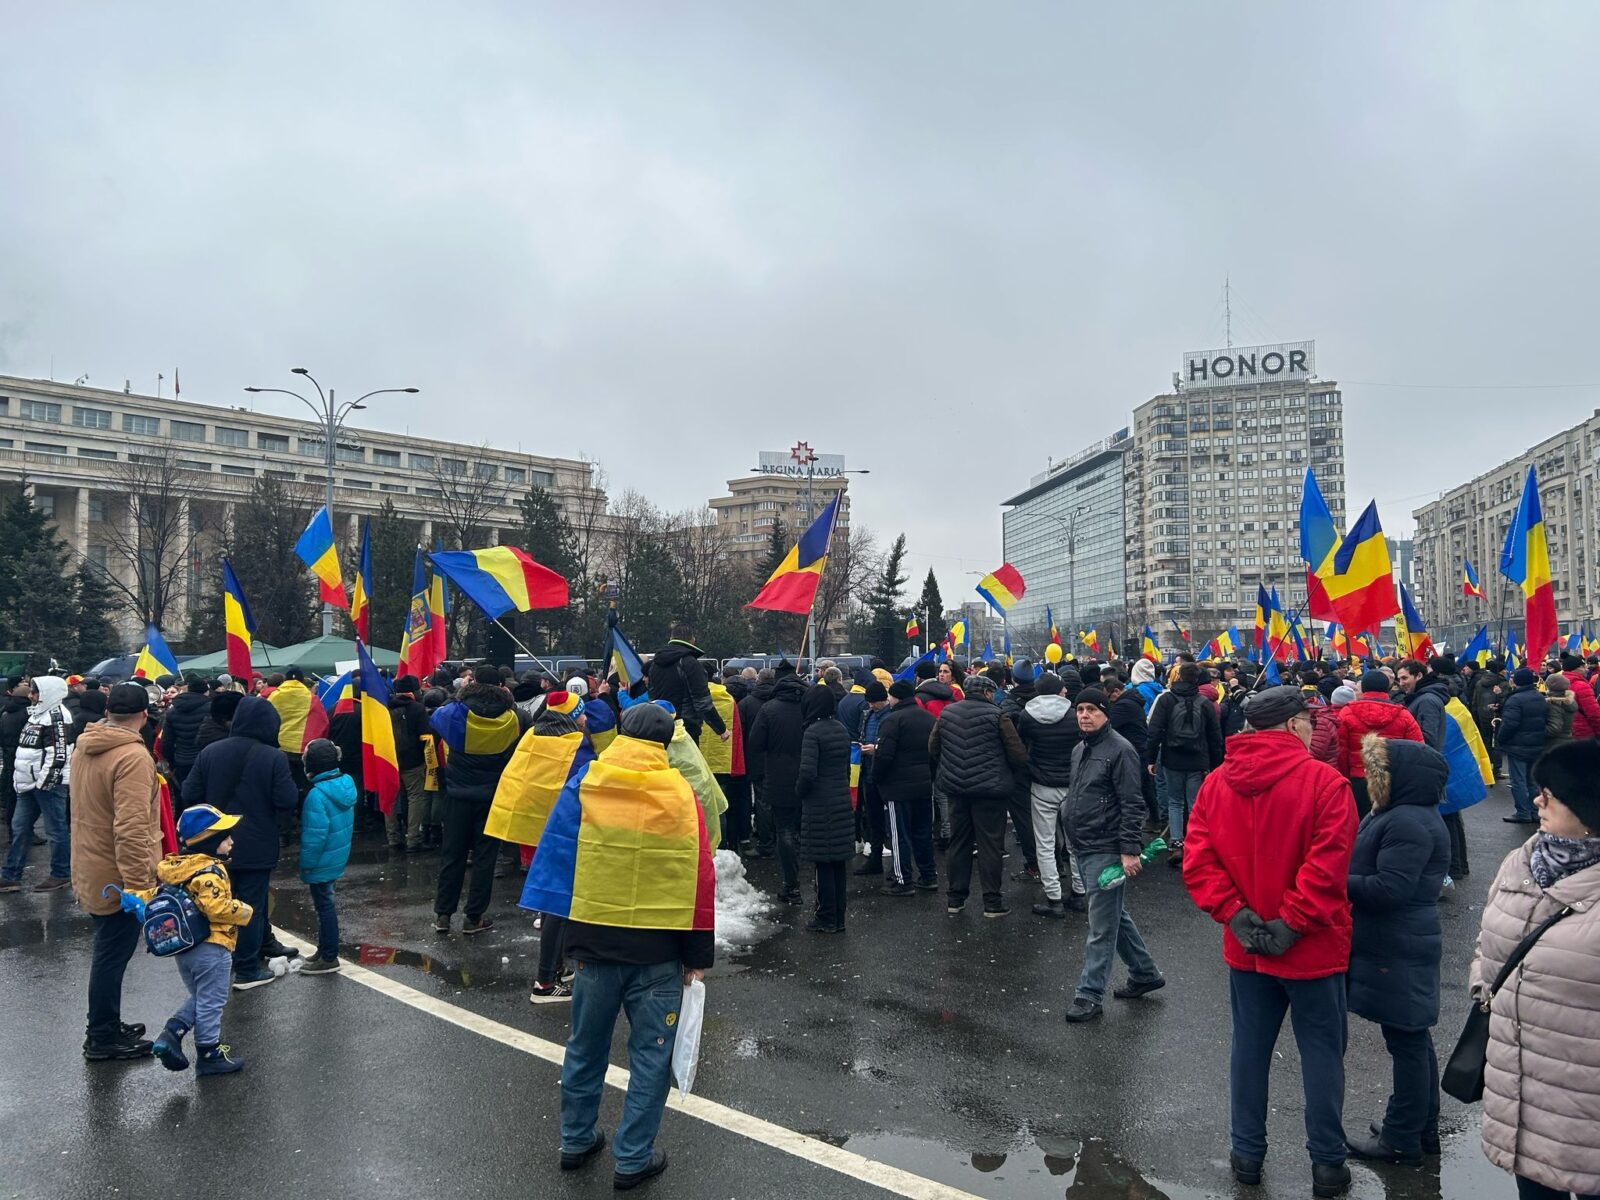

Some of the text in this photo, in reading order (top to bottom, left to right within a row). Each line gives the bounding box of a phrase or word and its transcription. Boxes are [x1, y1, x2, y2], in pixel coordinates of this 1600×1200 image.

[1190, 350, 1308, 381] HONOR
[762, 465, 842, 477] REGINA MARIA
